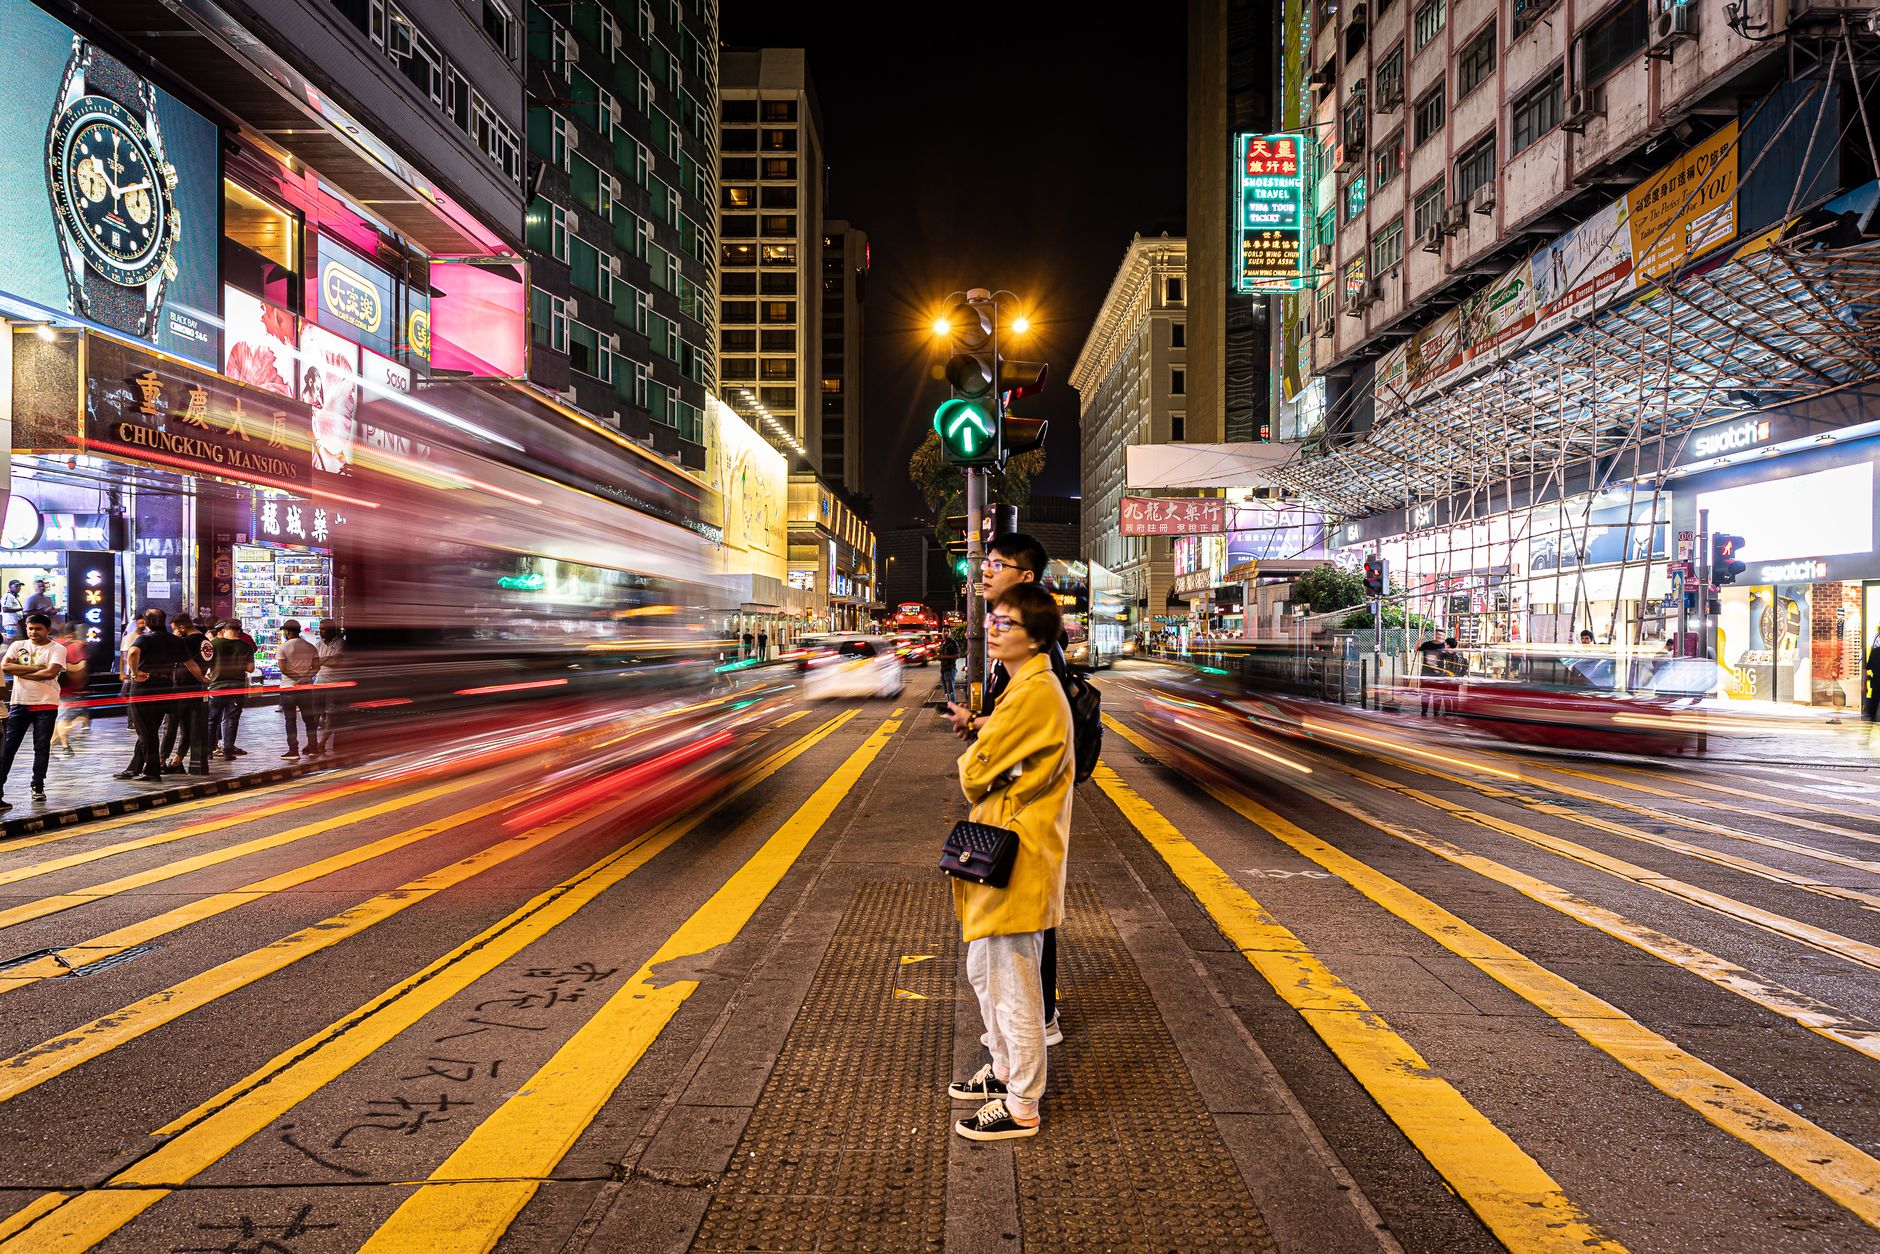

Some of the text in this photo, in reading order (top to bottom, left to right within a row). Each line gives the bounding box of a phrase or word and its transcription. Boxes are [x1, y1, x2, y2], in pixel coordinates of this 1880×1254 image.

[1250, 140, 1295, 158] 天星
[1249, 161, 1296, 173] 旅行社
[1243, 177, 1300, 187] SHOESTRING
[1700, 171, 1733, 206] YOU
[1255, 190, 1289, 199] TRAVEL
[1249, 204, 1295, 212] VISA TOUR
[1250, 214, 1280, 222] TICKET
[170, 311, 197, 329] BLACK BAY
[1695, 420, 1758, 457] swatch
[120, 422, 297, 479] CHUNGKING MANSIONS
[1124, 502, 1221, 521] 九龍大藥行
[1258, 510, 1293, 527] ISA
[1761, 560, 1816, 582] swatch
[1734, 667, 1757, 685] BIG
[1733, 683, 1757, 695] BOLD
